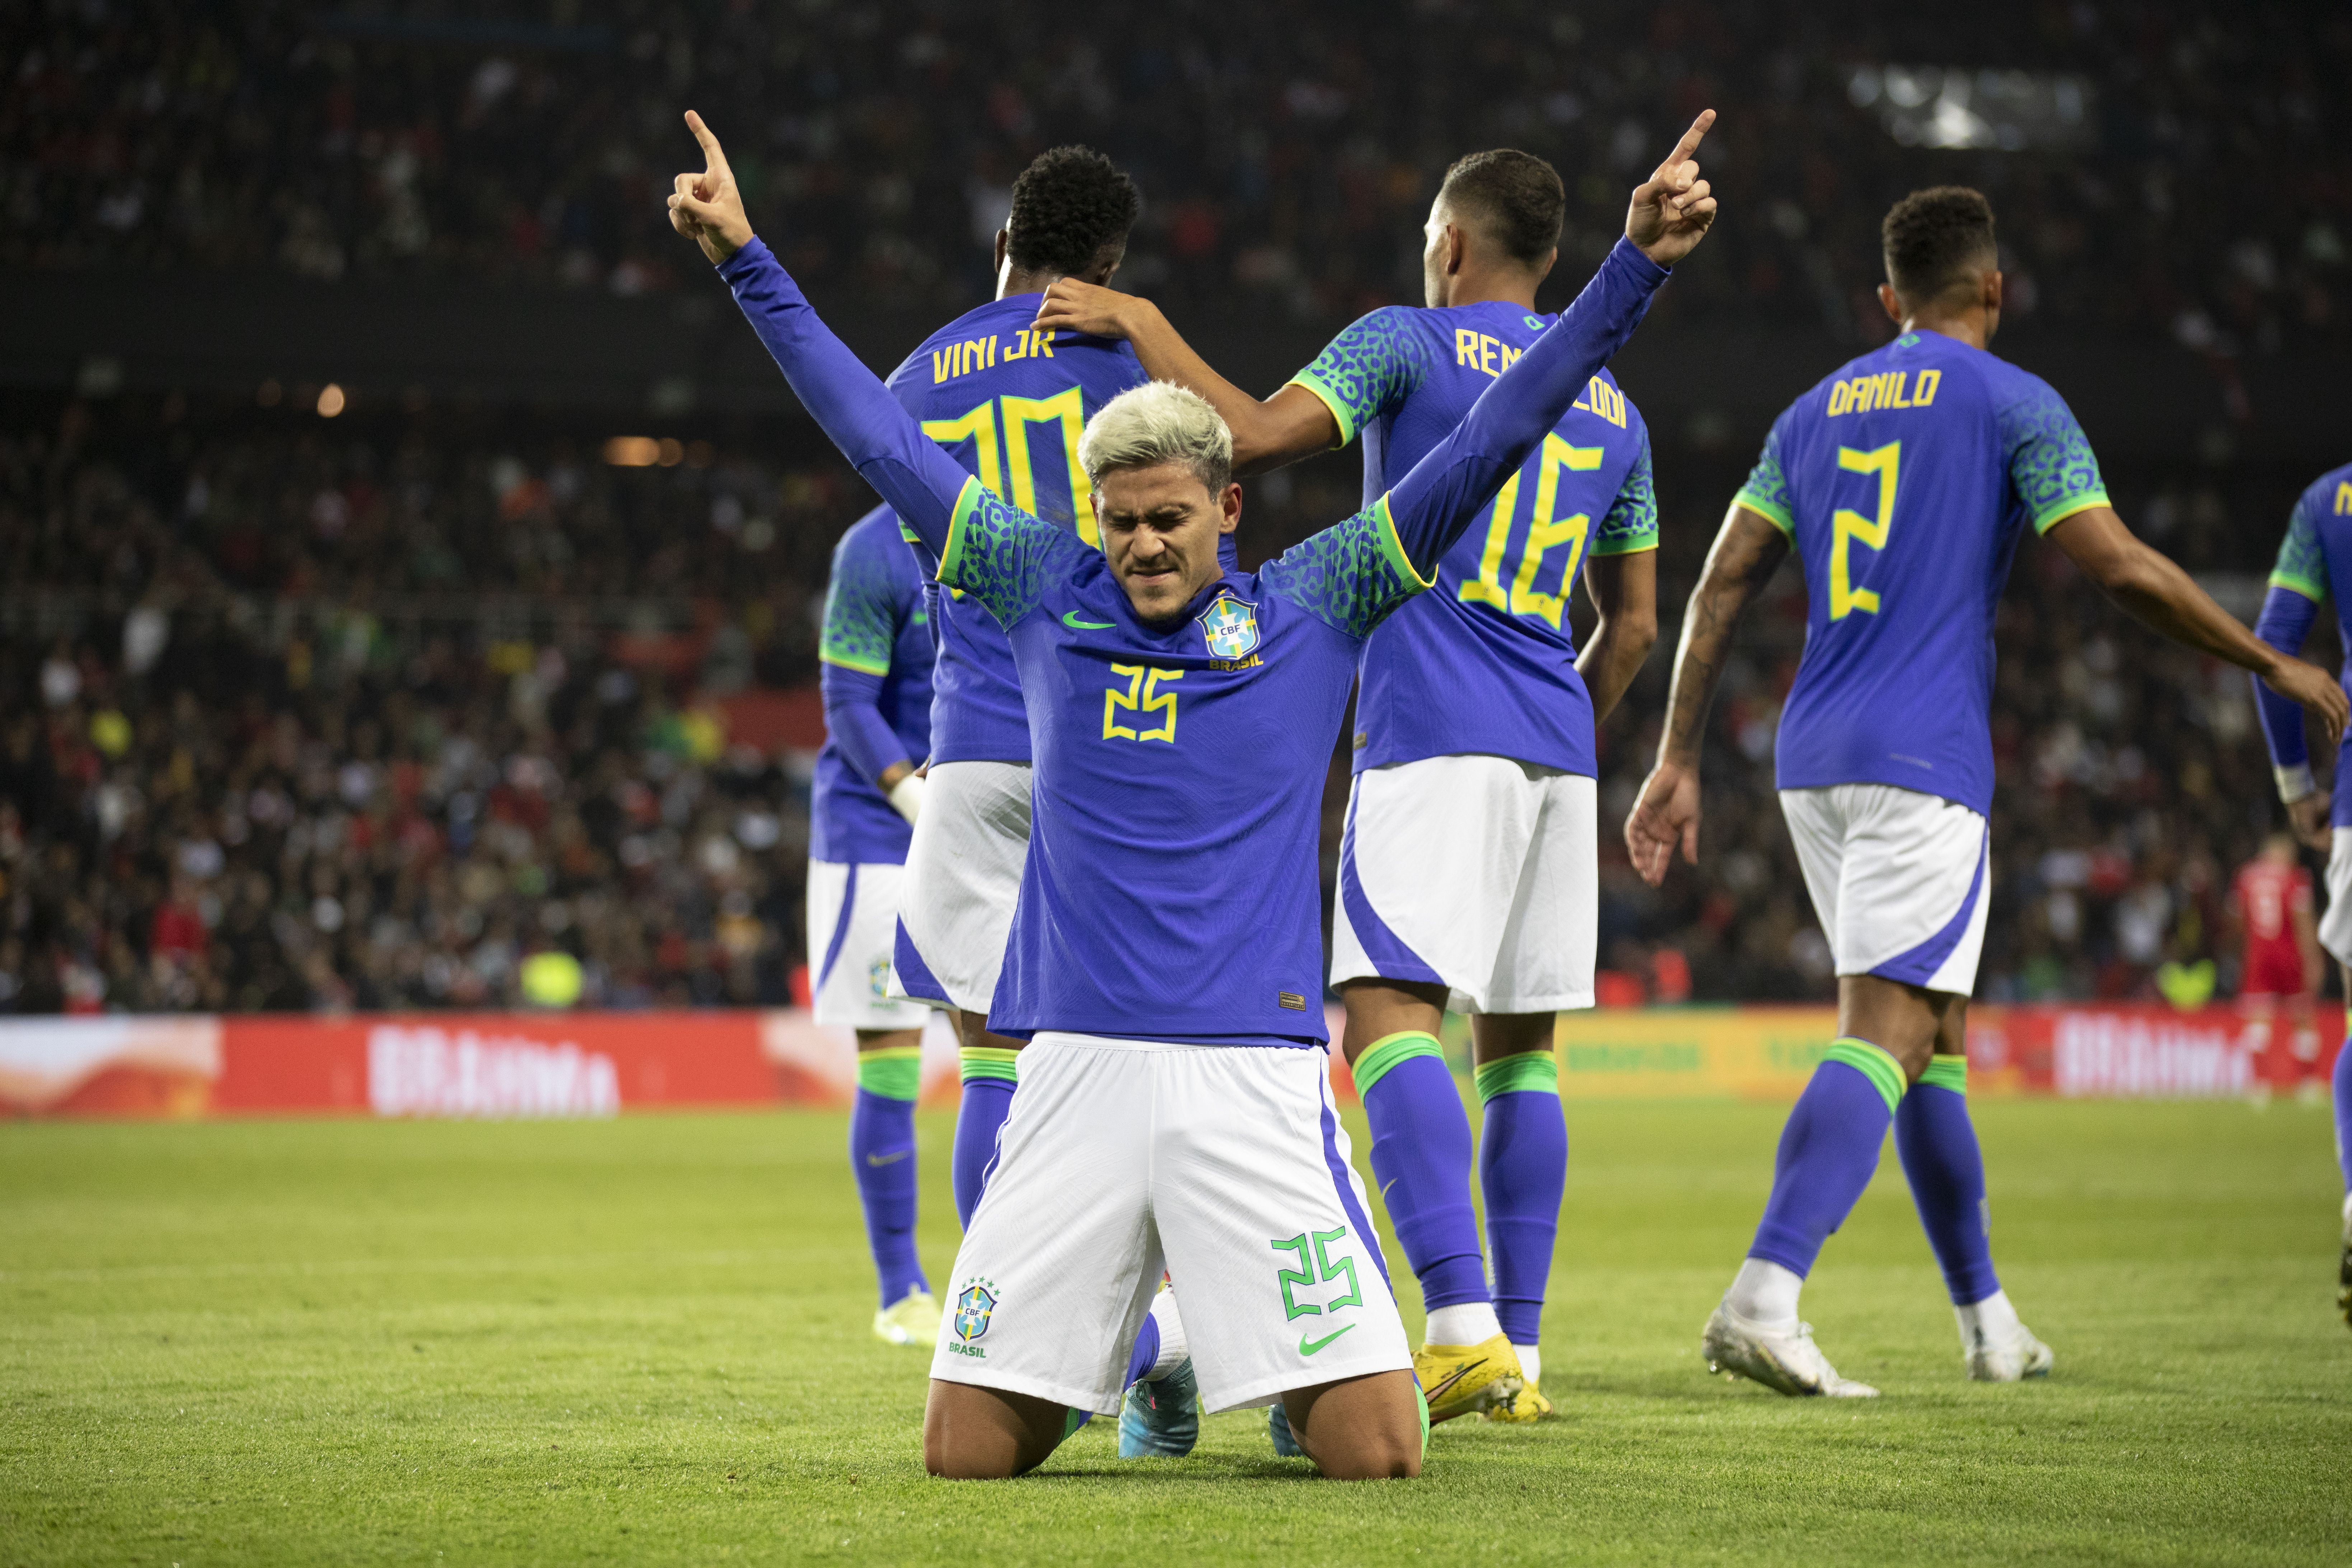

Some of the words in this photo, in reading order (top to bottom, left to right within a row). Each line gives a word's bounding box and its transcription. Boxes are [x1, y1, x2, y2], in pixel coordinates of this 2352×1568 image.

[934, 335, 997, 384] VINI
[1004, 328, 1055, 362] JR
[1455, 328, 1522, 378] REN
[1827, 369, 1942, 417] DANILO
[921, 384, 1102, 551] 10
[1458, 431, 1604, 631] 16
[1829, 439, 1902, 622] 2
[1220, 624, 1241, 636] CBF
[1209, 653, 1264, 672] BRASIL
[1102, 661, 1184, 744] 25
[1271, 1225, 1363, 1322] 25
[965, 1308, 980, 1316] CBF
[949, 1342, 987, 1358] BRASIL
